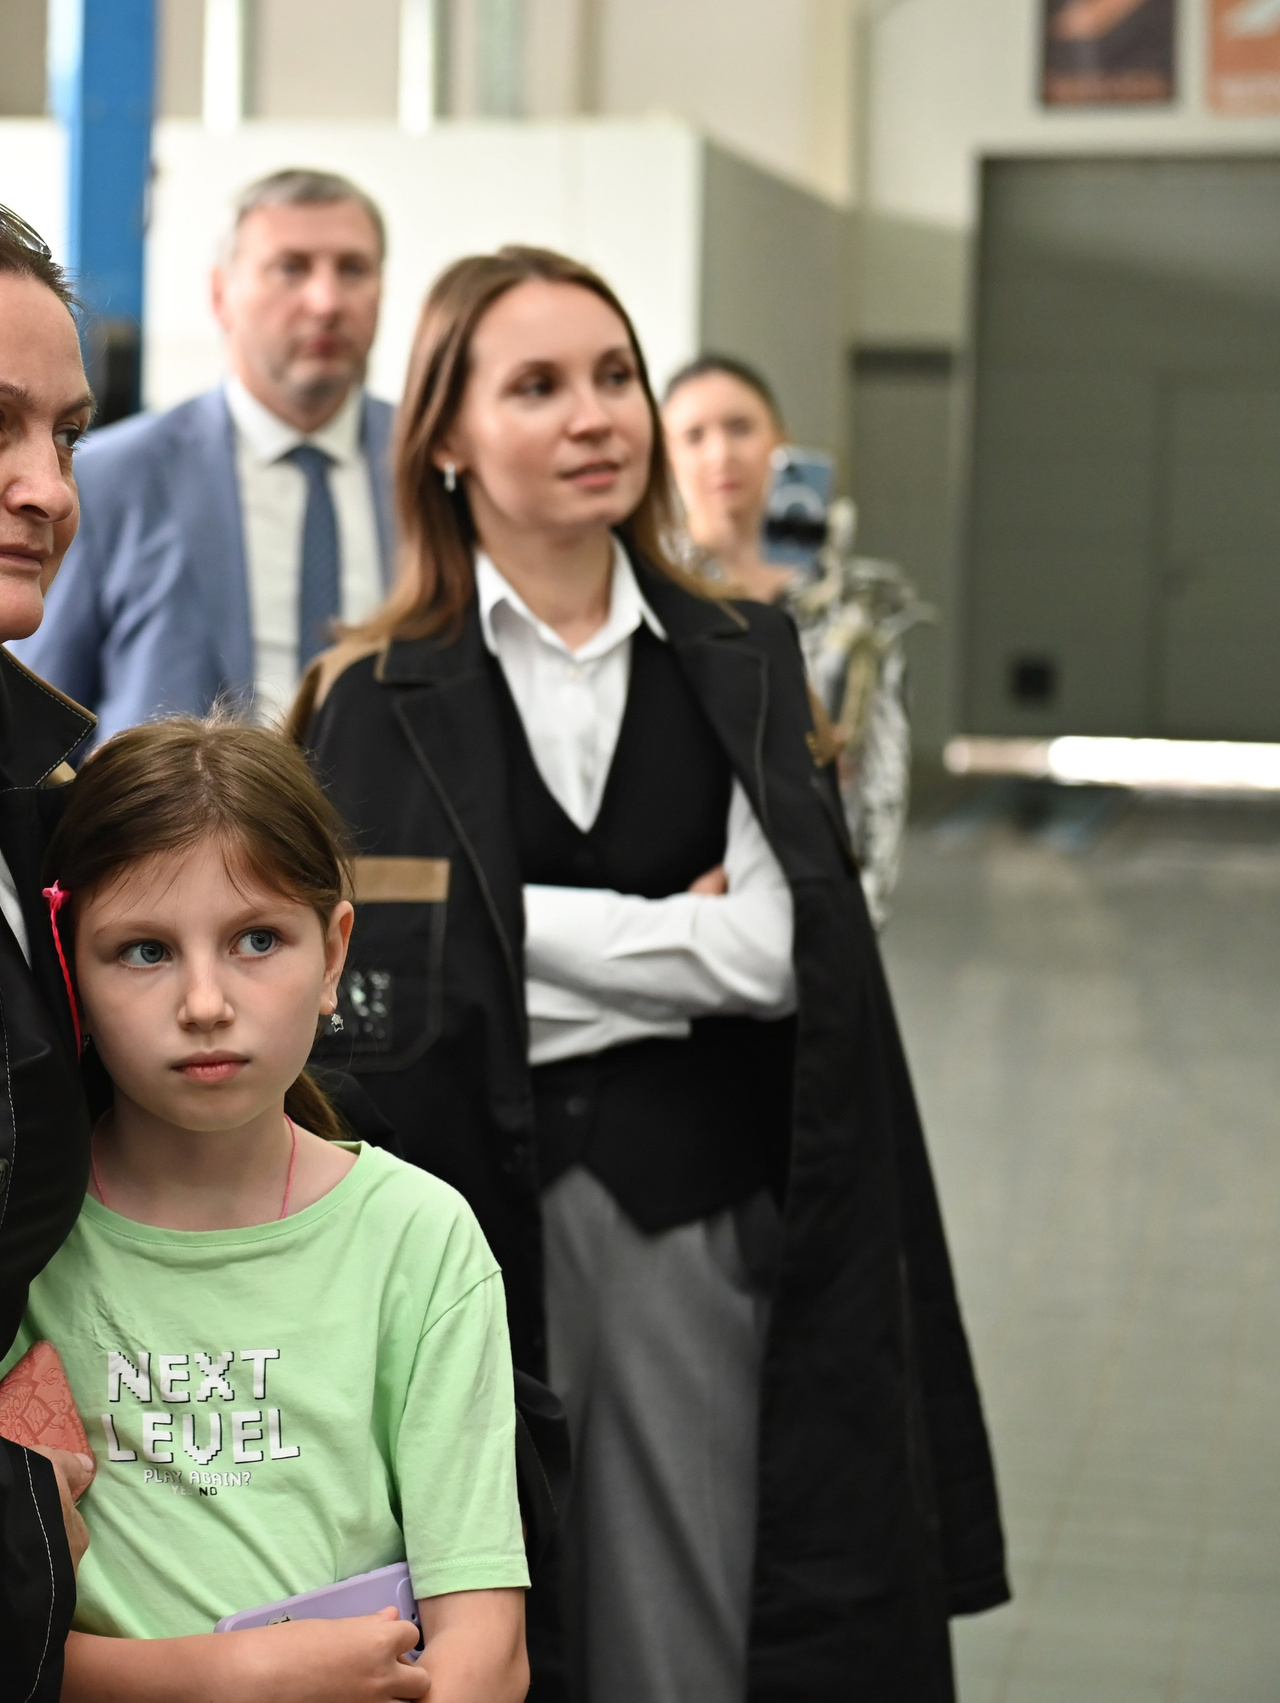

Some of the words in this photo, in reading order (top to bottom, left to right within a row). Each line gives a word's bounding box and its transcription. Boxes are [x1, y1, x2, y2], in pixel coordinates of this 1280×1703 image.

[108, 1349, 280, 1403] NEXT
[102, 1409, 300, 1465] LEVEL
[144, 1468, 183, 1484] PLAY
[189, 1470, 252, 1487] AGAIN?
[199, 1486, 218, 1497] NO
